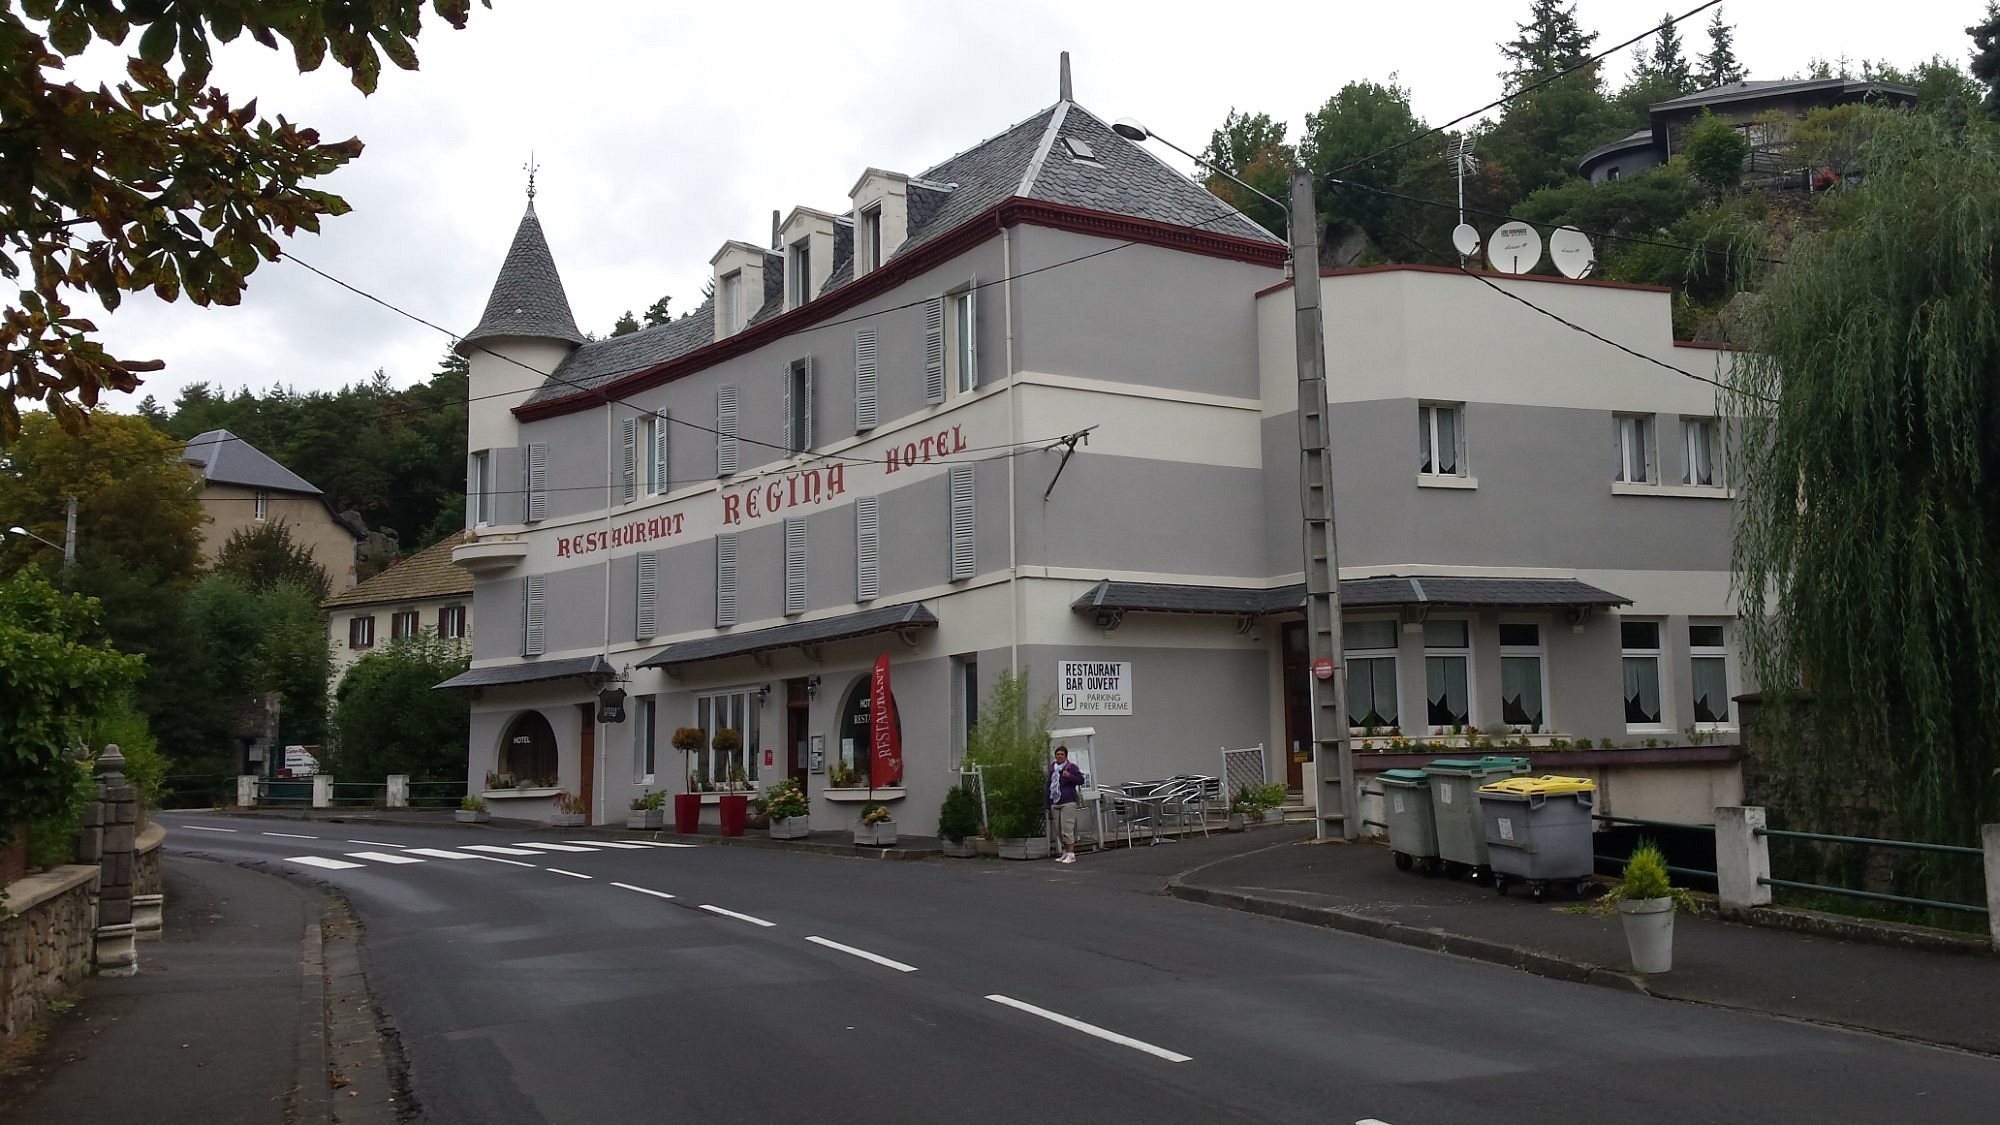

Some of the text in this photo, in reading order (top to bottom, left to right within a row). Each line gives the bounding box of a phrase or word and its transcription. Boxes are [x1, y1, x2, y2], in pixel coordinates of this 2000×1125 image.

[557, 424, 967, 558] RESTAURANT REGINA HOTEL
[1065, 664, 1121, 676] RESTAURANT
[1066, 677, 1119, 690] BAR OUVERT
[860, 698, 871, 708] HOT
[1087, 693, 1121, 702] PARKING
[1079, 702, 1129, 710] PRIVE FERME
[876, 666, 892, 759] RESTAURANT
[513, 736, 531, 744] HOTEL
